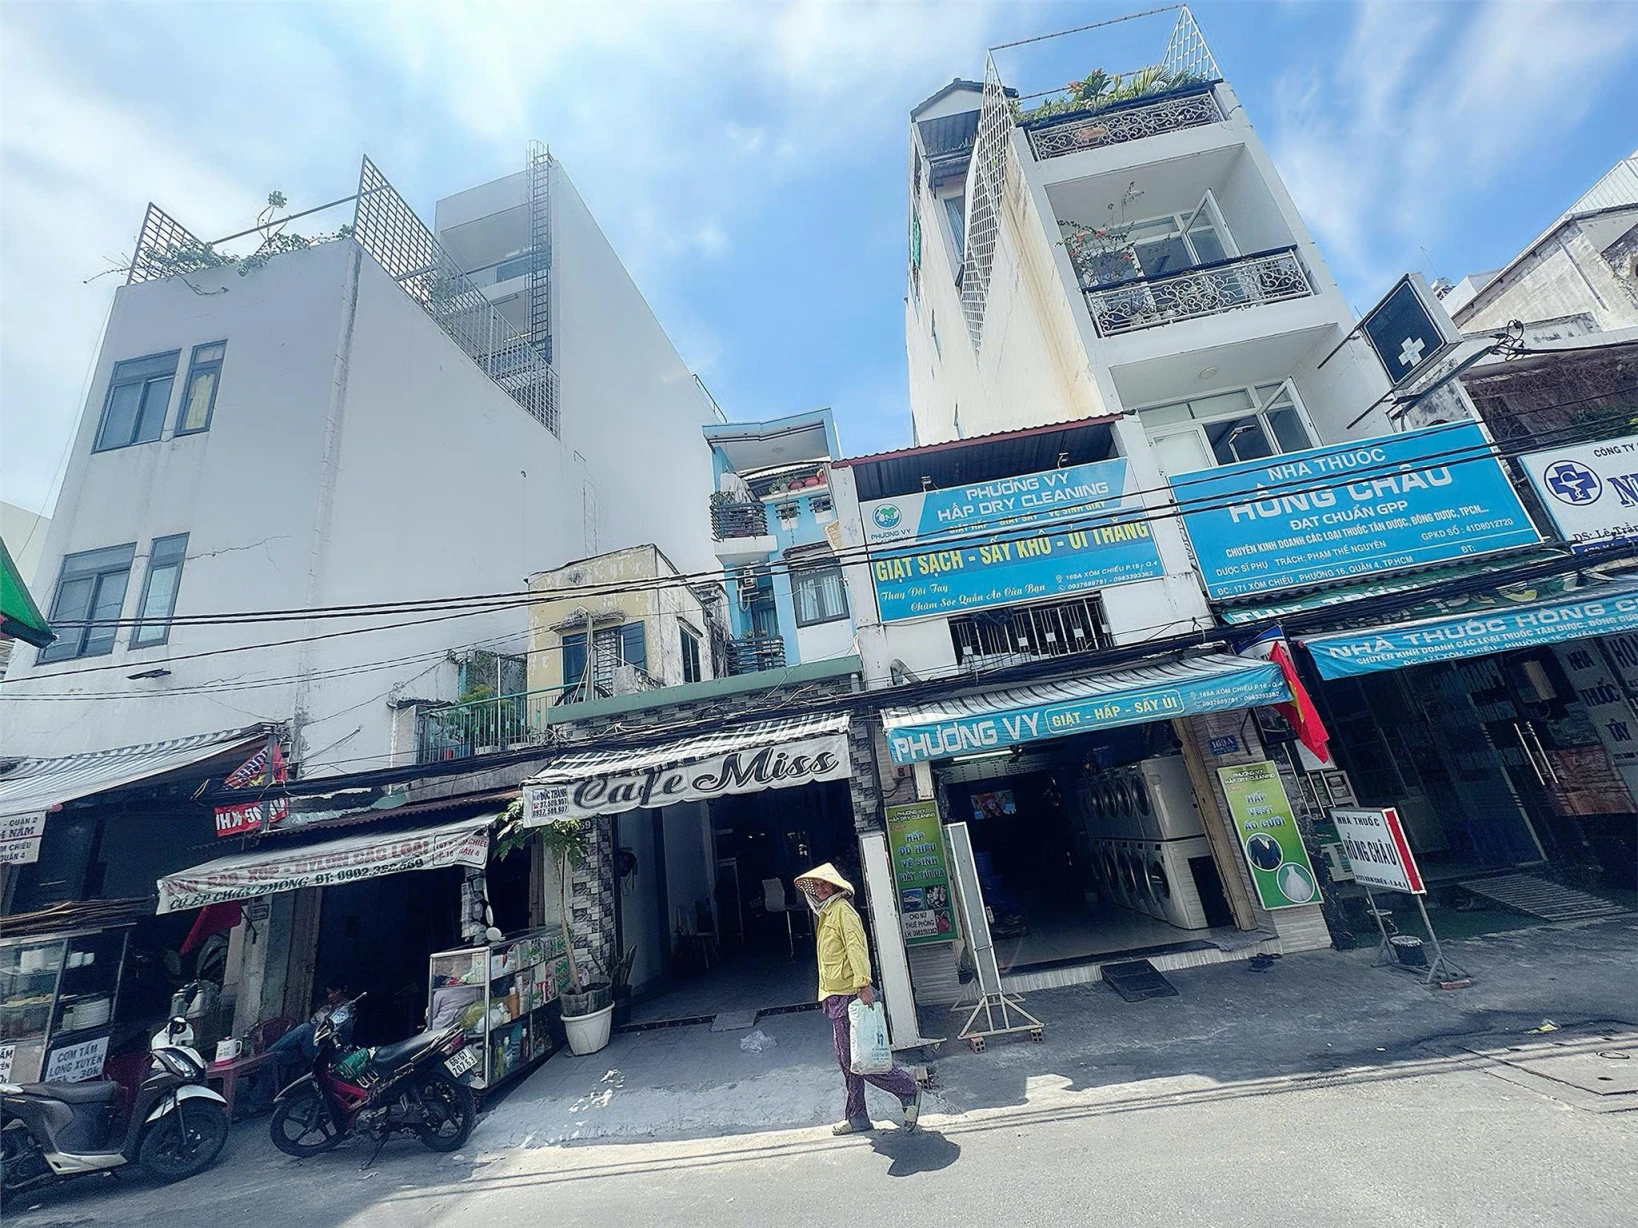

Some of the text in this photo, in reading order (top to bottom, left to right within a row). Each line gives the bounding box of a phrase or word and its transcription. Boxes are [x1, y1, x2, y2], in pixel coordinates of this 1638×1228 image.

[1593, 443, 1636, 458] CÔNG TY
[966, 472, 1070, 501] PHƯƠNG VY
[1227, 463, 1453, 523] HỒNG CHÂU
[937, 482, 1110, 522] HẤP DRY CLEANING
[1290, 500, 1409, 532] ĐẠT CHUẨN GPP
[900, 528, 912, 536] VY
[1226, 545, 1258, 558] CHUYÊN
[1258, 540, 1277, 553] KINH
[1278, 536, 1305, 549] DOANH
[1305, 530, 1323, 545] CÁC
[1323, 528, 1342, 542] LOẠI
[1343, 522, 1369, 538] THUỐC
[1370, 519, 1387, 533] TÂN
[1421, 531, 1447, 542] GPKD
[1447, 525, 1460, 538] SỐ
[918, 550, 964, 577] SẠCH
[979, 536, 1012, 565] SẤY
[1016, 529, 1052, 558] KHÔ
[1216, 566, 1240, 577] DƯỢC
[1250, 560, 1268, 571] PHỤ
[1275, 554, 1307, 567] TRÁCH:
[1307, 551, 1332, 563] PHẠM
[1333, 545, 1350, 558] THẾ
[1461, 544, 1477, 555] ĐT:
[1216, 586, 1233, 597] ĐC:
[1234, 583, 1247, 593] 171
[1247, 577, 1268, 591] XÓM
[1269, 574, 1294, 587] CHIẾU
[1299, 569, 1334, 582] PHƯỜNG
[1350, 561, 1373, 576] QUẬN
[1383, 556, 1414, 569] TP.HCM
[880, 583, 948, 602] Thay Tay
[1515, 603, 1606, 628] HỒNG
[1329, 618, 1507, 659] NHÀ THUỐC
[1396, 648, 1421, 659] KINH
[1421, 643, 1455, 654] DOANH
[1456, 638, 1476, 651] CÁC
[1503, 628, 1534, 643] THUỐC
[1051, 694, 1179, 727] GIẶT HẤP SẤY ỦI
[893, 712, 1039, 763] PHƯƠNG VY
[1211, 737, 1234, 750] 169A
[691, 746, 840, 794] Miss
[1336, 815, 1380, 827] NHÀ THUỐC
[916, 855, 938, 867] SINH
[1343, 832, 1371, 862] HỒNG
[1368, 839, 1397, 866] CHÂU
[934, 868, 945, 879] DA
[48, 1053, 105, 1078] LONG XUYÊN
[57, 1042, 99, 1064] CƠM TẤM
